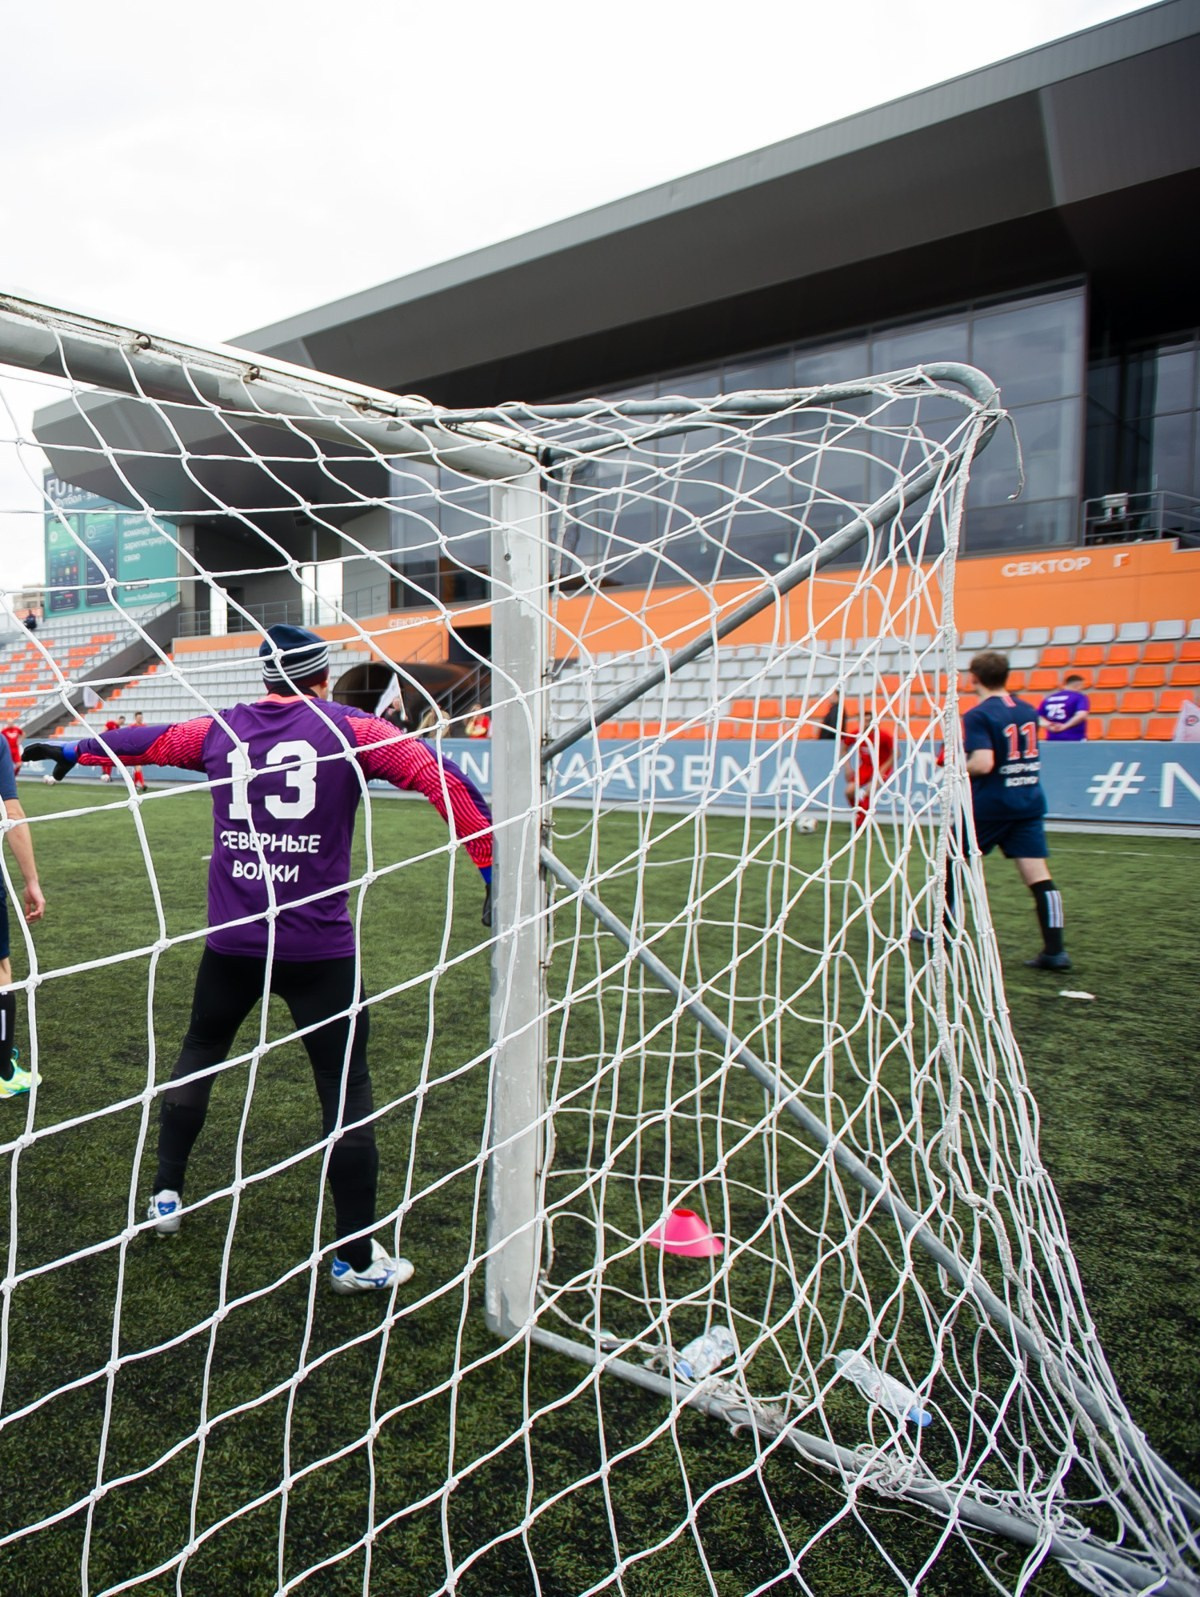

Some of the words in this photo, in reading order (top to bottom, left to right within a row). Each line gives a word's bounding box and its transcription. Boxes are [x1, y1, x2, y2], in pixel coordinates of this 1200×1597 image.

[1001, 556, 1092, 577] СЕКТОР
[1002, 721, 1040, 761] 11
[227, 740, 318, 820] 13
